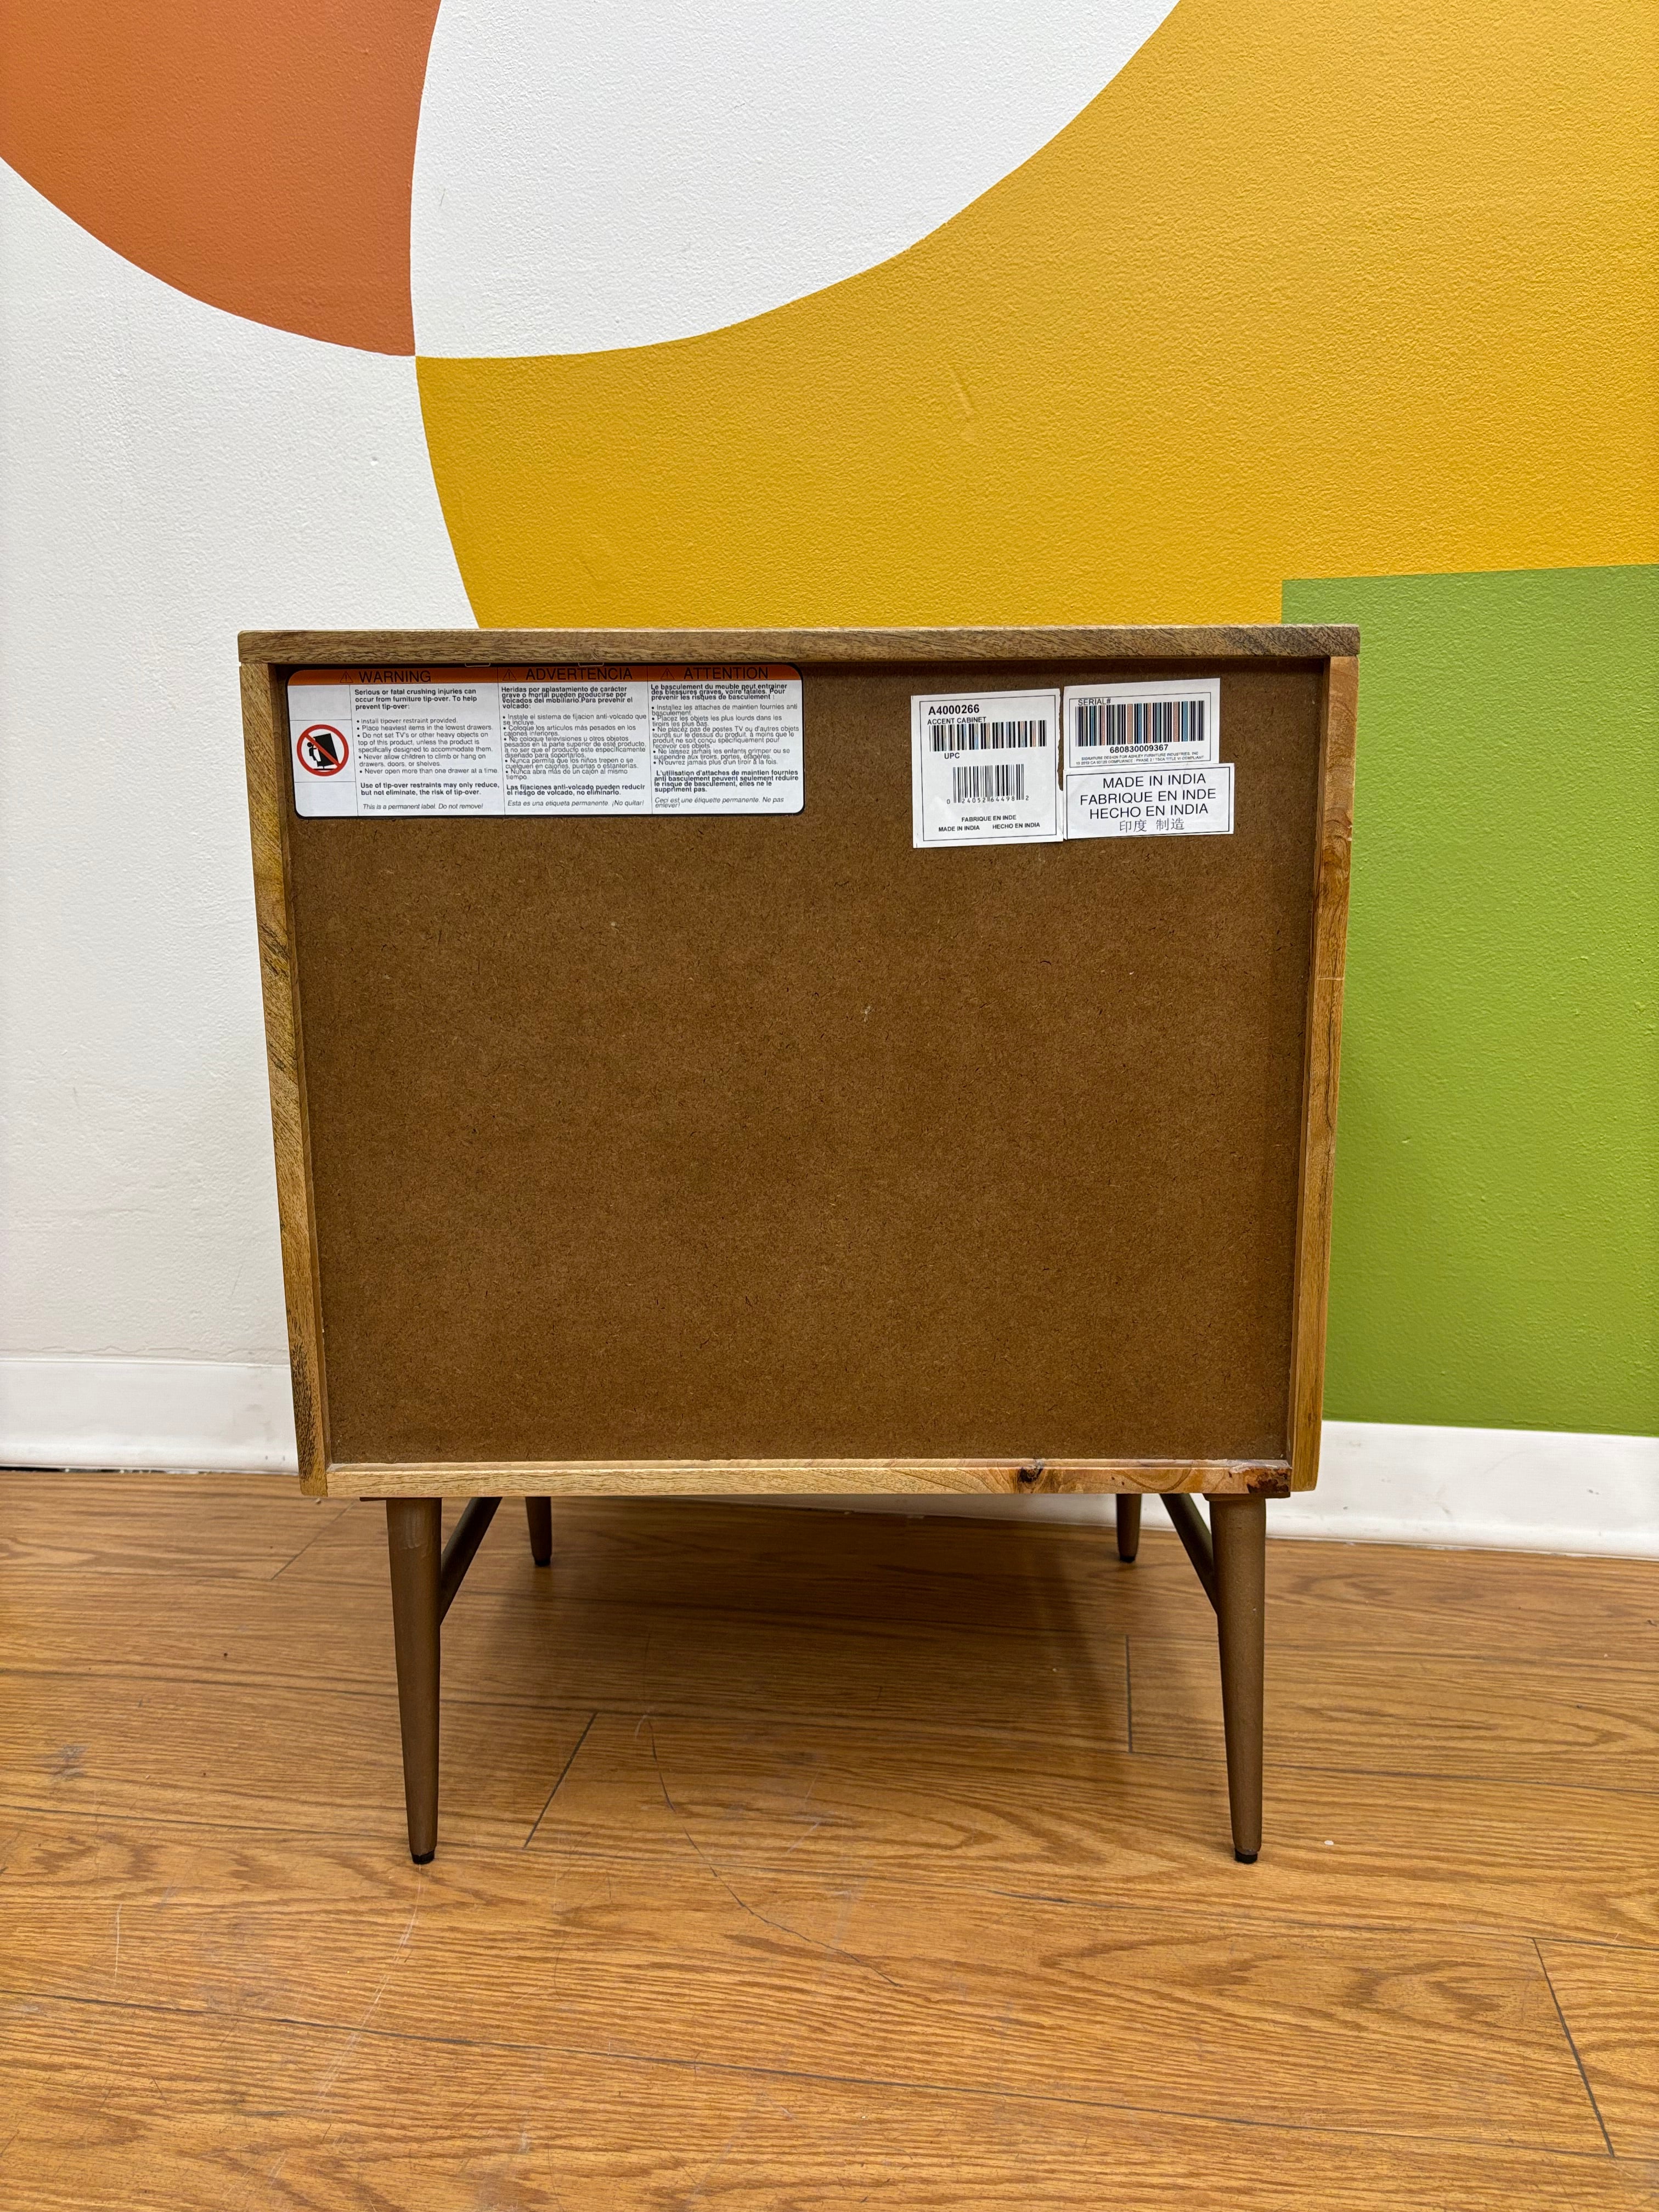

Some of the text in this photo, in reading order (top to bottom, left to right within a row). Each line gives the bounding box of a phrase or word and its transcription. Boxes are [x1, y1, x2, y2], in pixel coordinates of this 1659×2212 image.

[359, 670, 431, 682] WARNING
[526, 668, 633, 680] ADVERTENCIA
[684, 667, 768, 679] ATTENTION
[1078, 698, 1111, 706] SERIAL#
[928, 704, 980, 715] A4000266
[1110, 744, 1169, 753] 680830009367
[1103, 773, 1206, 788] MADE IN INDIA
[1080, 788, 1216, 805] FABRIQUE EN INDE
[1090, 803, 1208, 819] HECHO EN INDIA
[1119, 817, 1184, 833] 印度 制造
